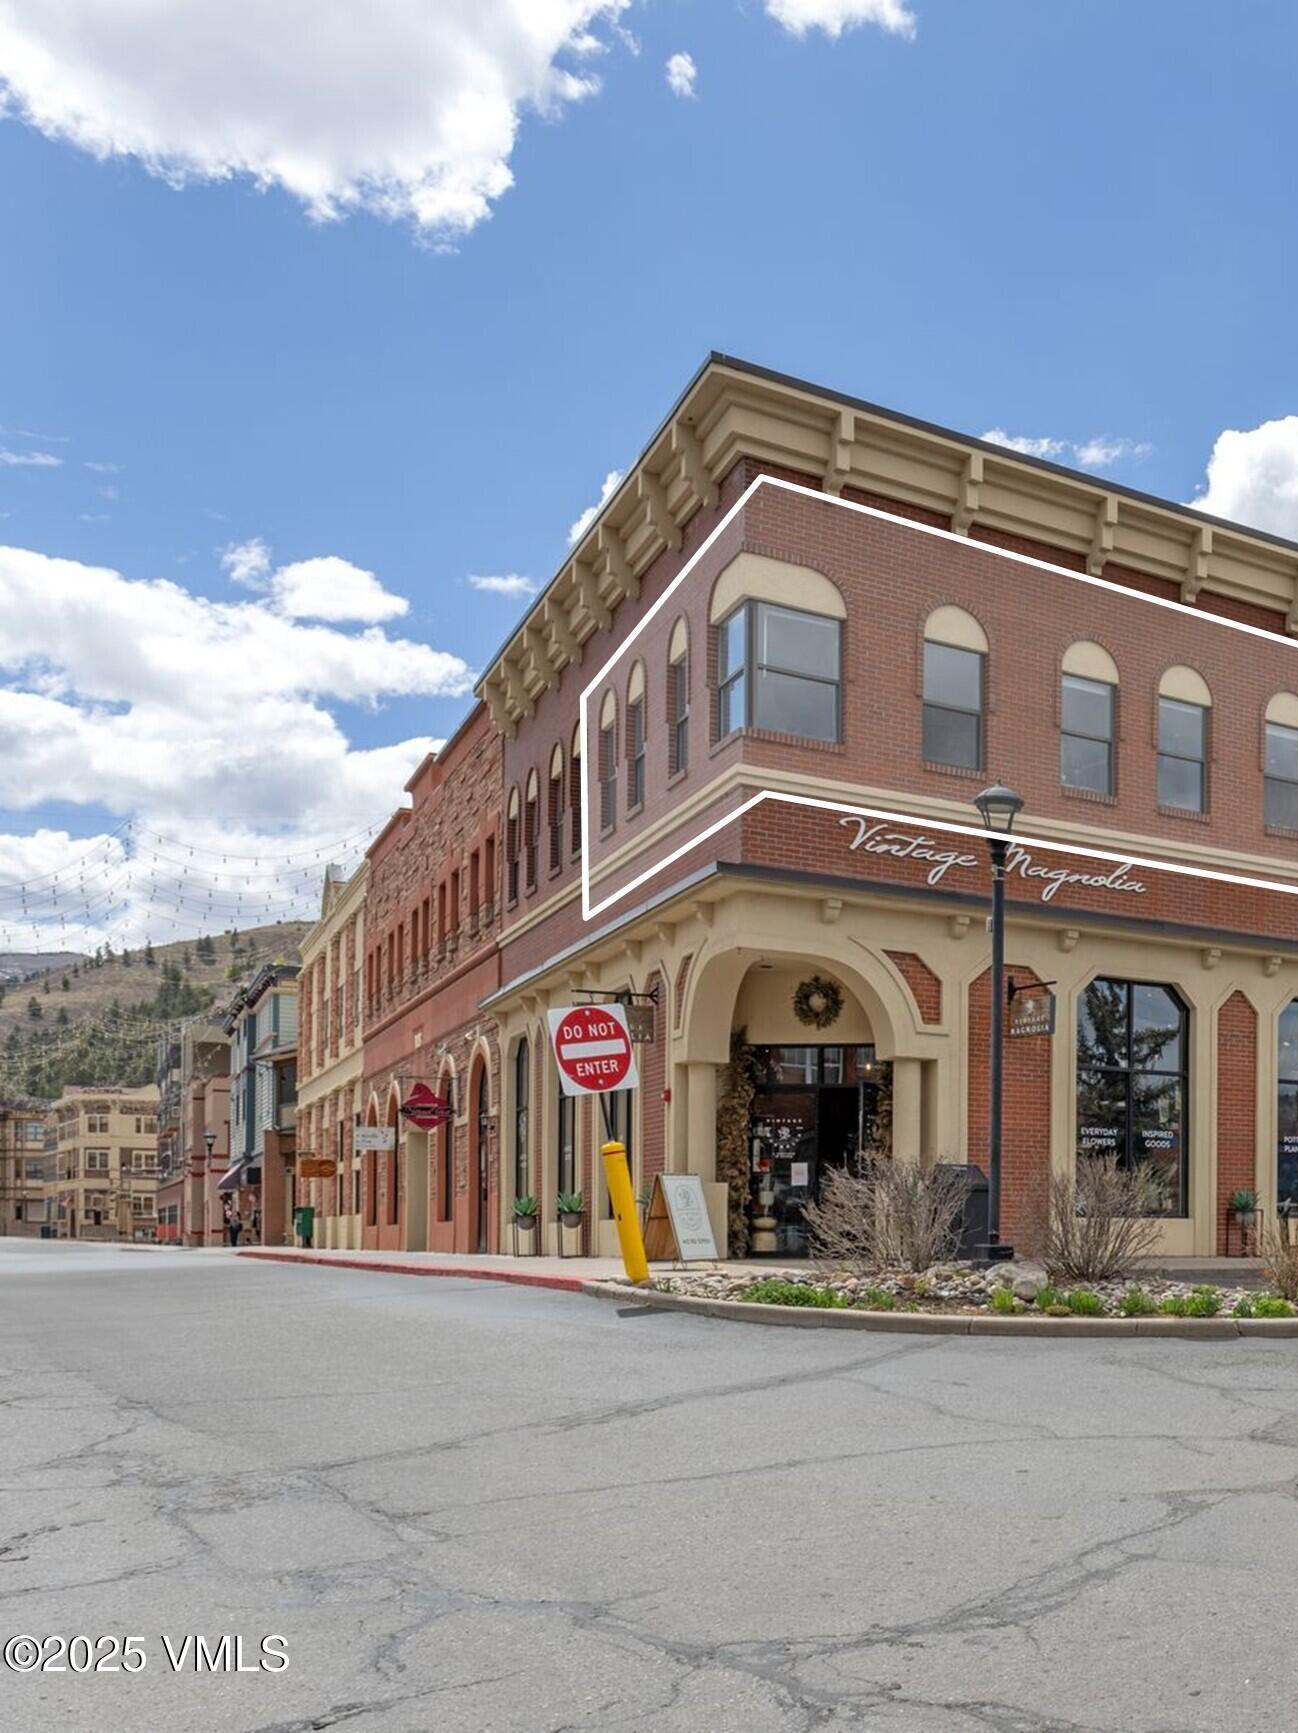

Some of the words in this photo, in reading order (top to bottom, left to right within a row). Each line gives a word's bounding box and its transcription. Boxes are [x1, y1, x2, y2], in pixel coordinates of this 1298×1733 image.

[839, 816, 978, 886] Vintage
[1004, 841, 1147, 902] Magnolia
[563, 1025, 582, 1040] DO
[588, 1021, 616, 1037] NOT
[576, 1059, 619, 1077] ENTER
[1080, 1127, 1119, 1136] EVERYDAY
[1141, 1130, 1174, 1139] INSPIRED
[1082, 1137, 1116, 1147] FLOWERS
[1144, 1139, 1171, 1149] GOODS
